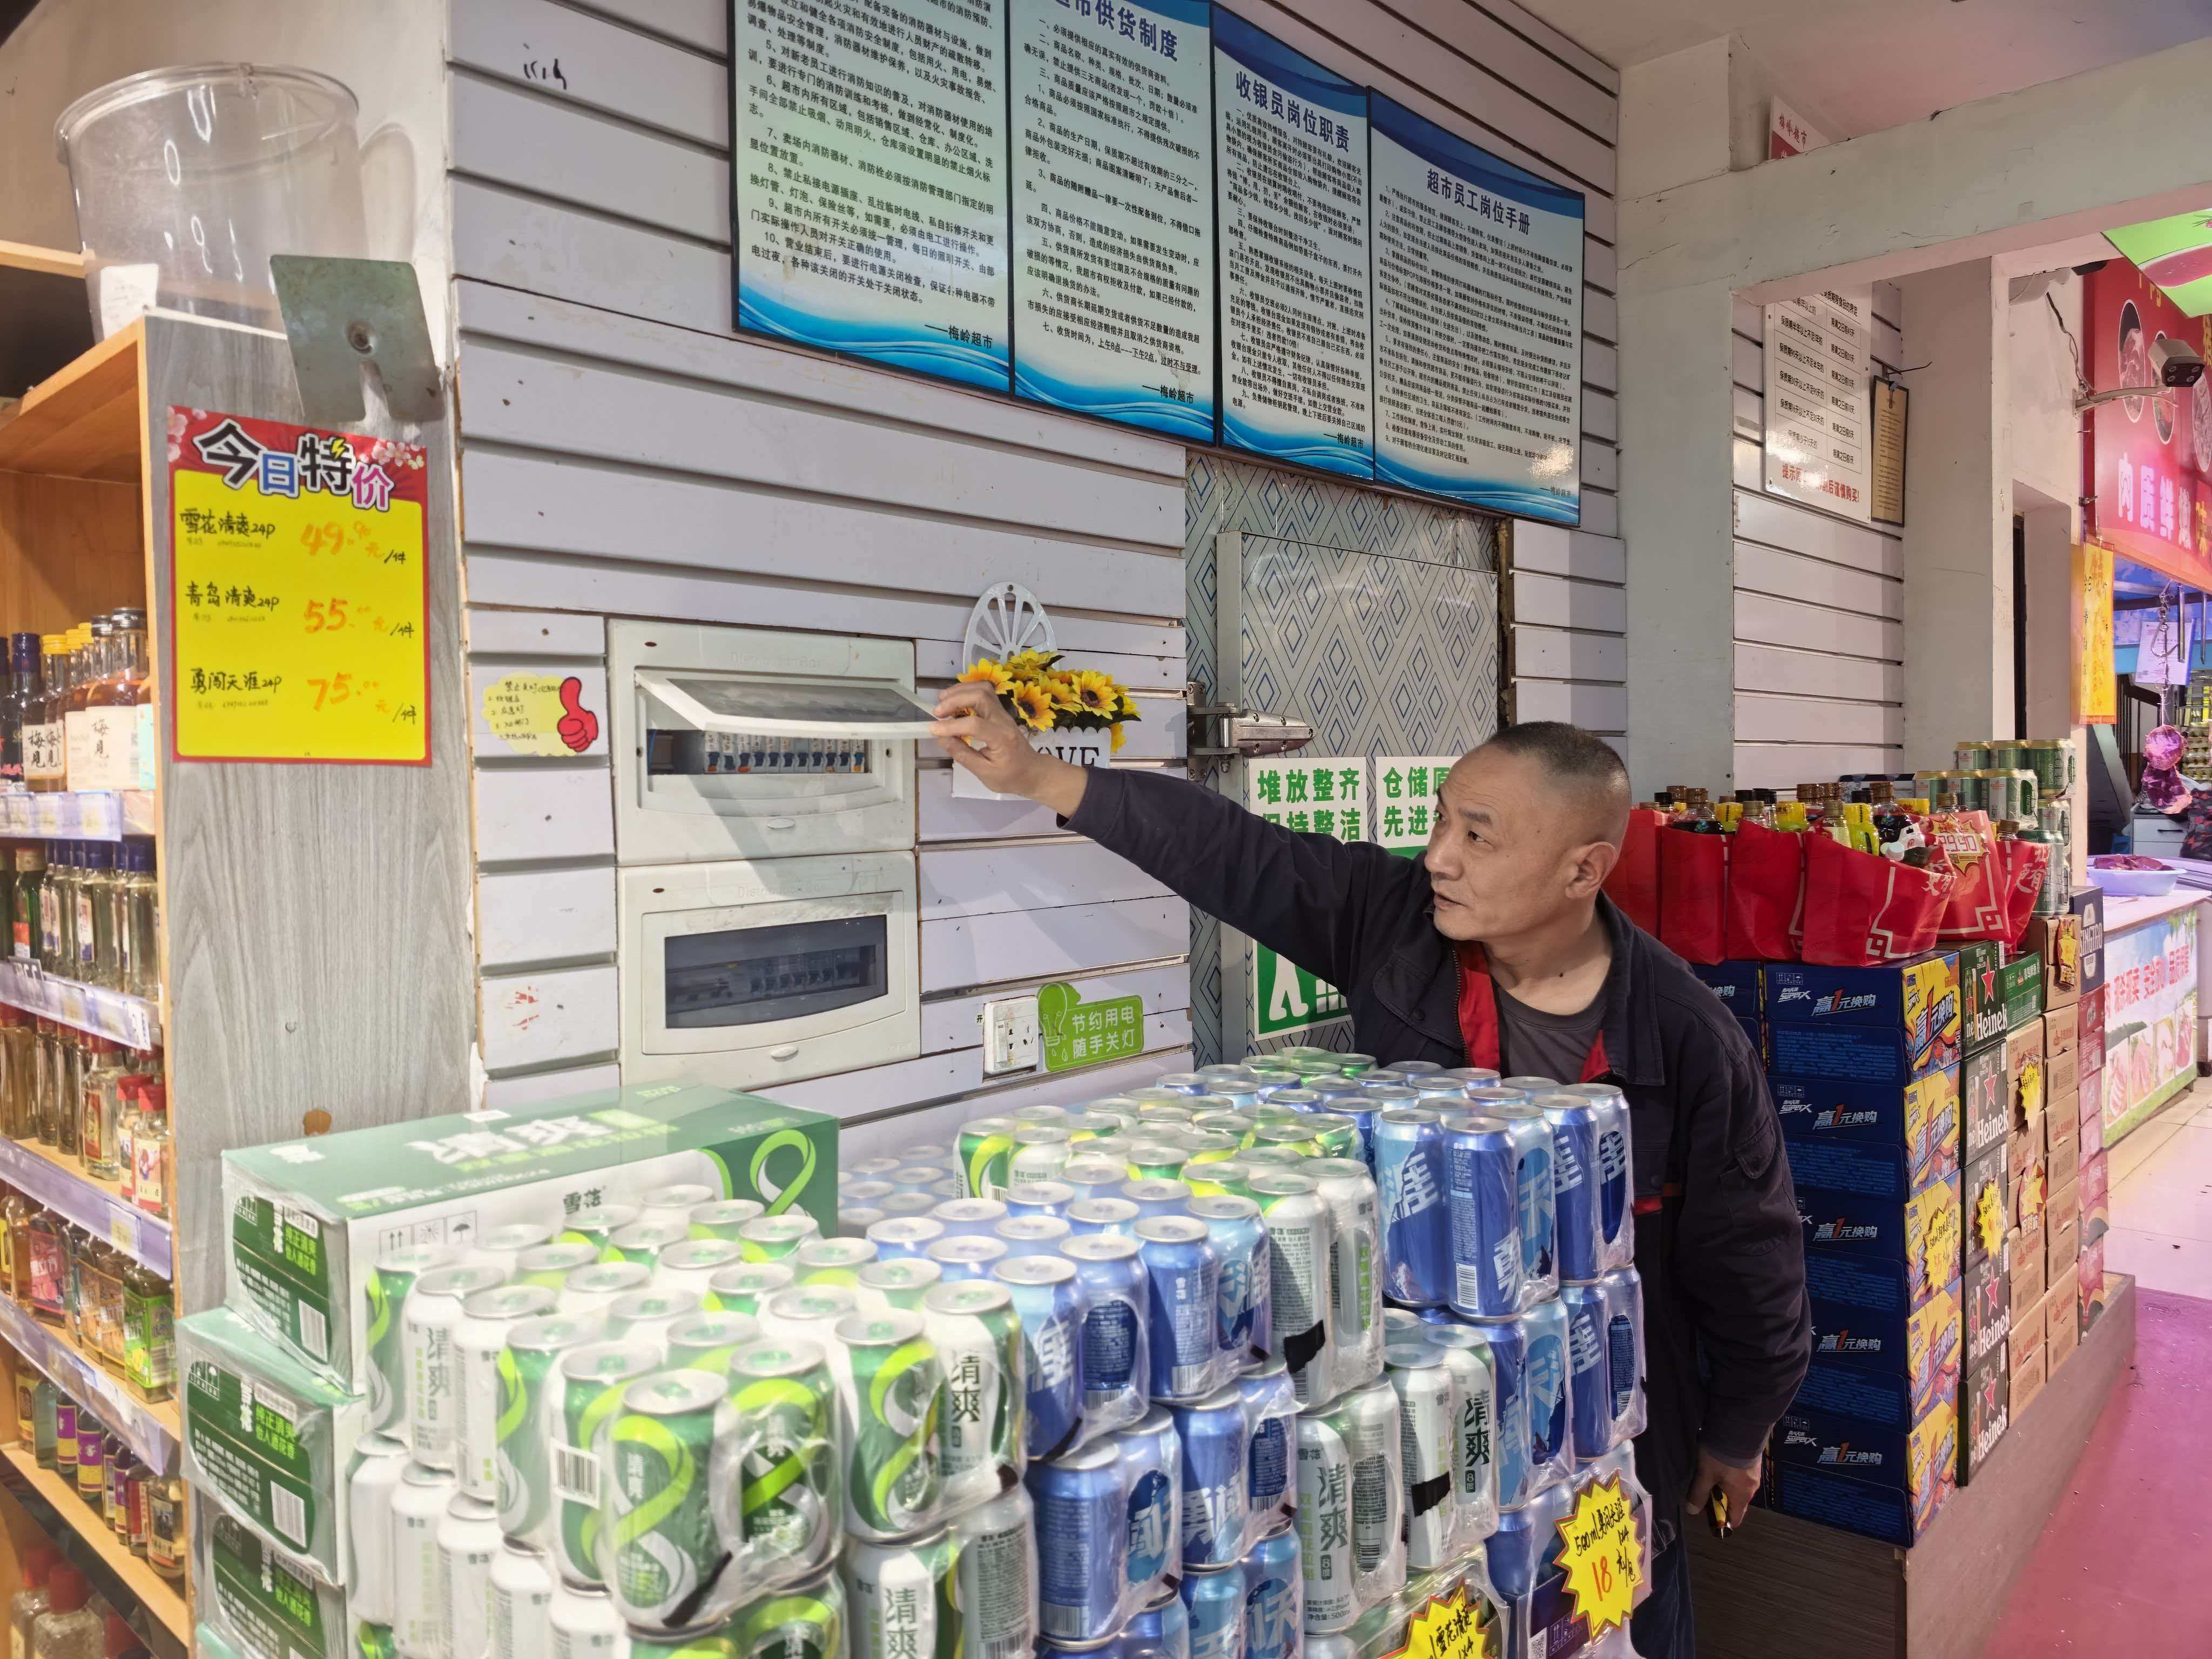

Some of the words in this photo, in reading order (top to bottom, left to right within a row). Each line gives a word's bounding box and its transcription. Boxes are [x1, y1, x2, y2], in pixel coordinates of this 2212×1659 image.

[1055, 0, 1178, 62] 市供货制度
[1235, 68, 1348, 154] 收银员岗位职责
[1427, 167, 1529, 237] 超市员工岗位手册
[194, 419, 393, 510] 今日特价
[1257, 767, 1360, 805] 堆放整齐
[1384, 805, 1439, 838] 先进
[1072, 1006, 1134, 1034] 节约用电
[1812, 988, 1877, 1016] 赢1元换购
[1073, 1028, 1135, 1059] 随手关灯
[1813, 1103, 1878, 1130] 赢1元换购
[1813, 1217, 1878, 1242] 赢1元换购
[1818, 1328, 1881, 1353] 赢1元换购
[950, 1351, 981, 1423] 清爽
[1464, 1390, 1491, 1467] 清爽
[1818, 1441, 1883, 1466] 赢1元换购
[1317, 1463, 1348, 1552] 清爽
[1591, 1555, 1613, 1602] 18
[884, 1587, 920, 1659] 清爽
